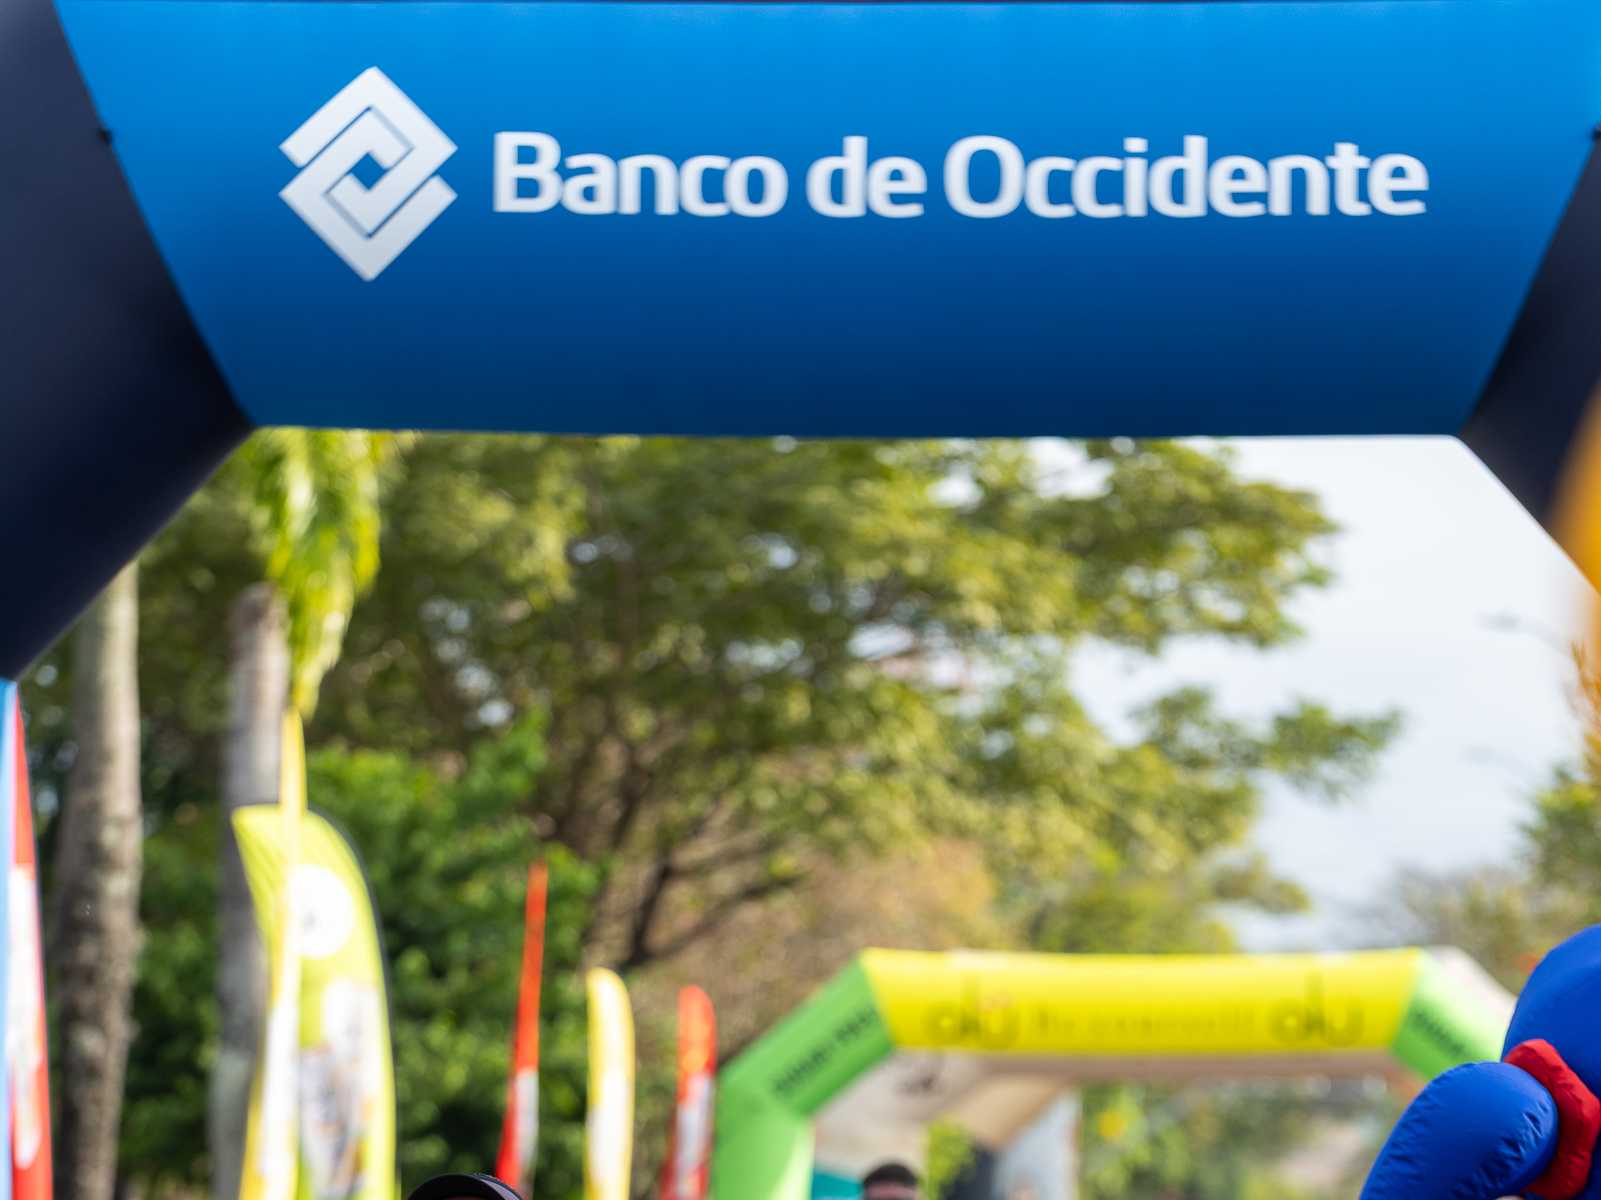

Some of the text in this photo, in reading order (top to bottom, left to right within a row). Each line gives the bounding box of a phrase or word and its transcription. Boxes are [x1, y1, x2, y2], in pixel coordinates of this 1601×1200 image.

[493, 130, 1430, 218] Banco de Occidente
